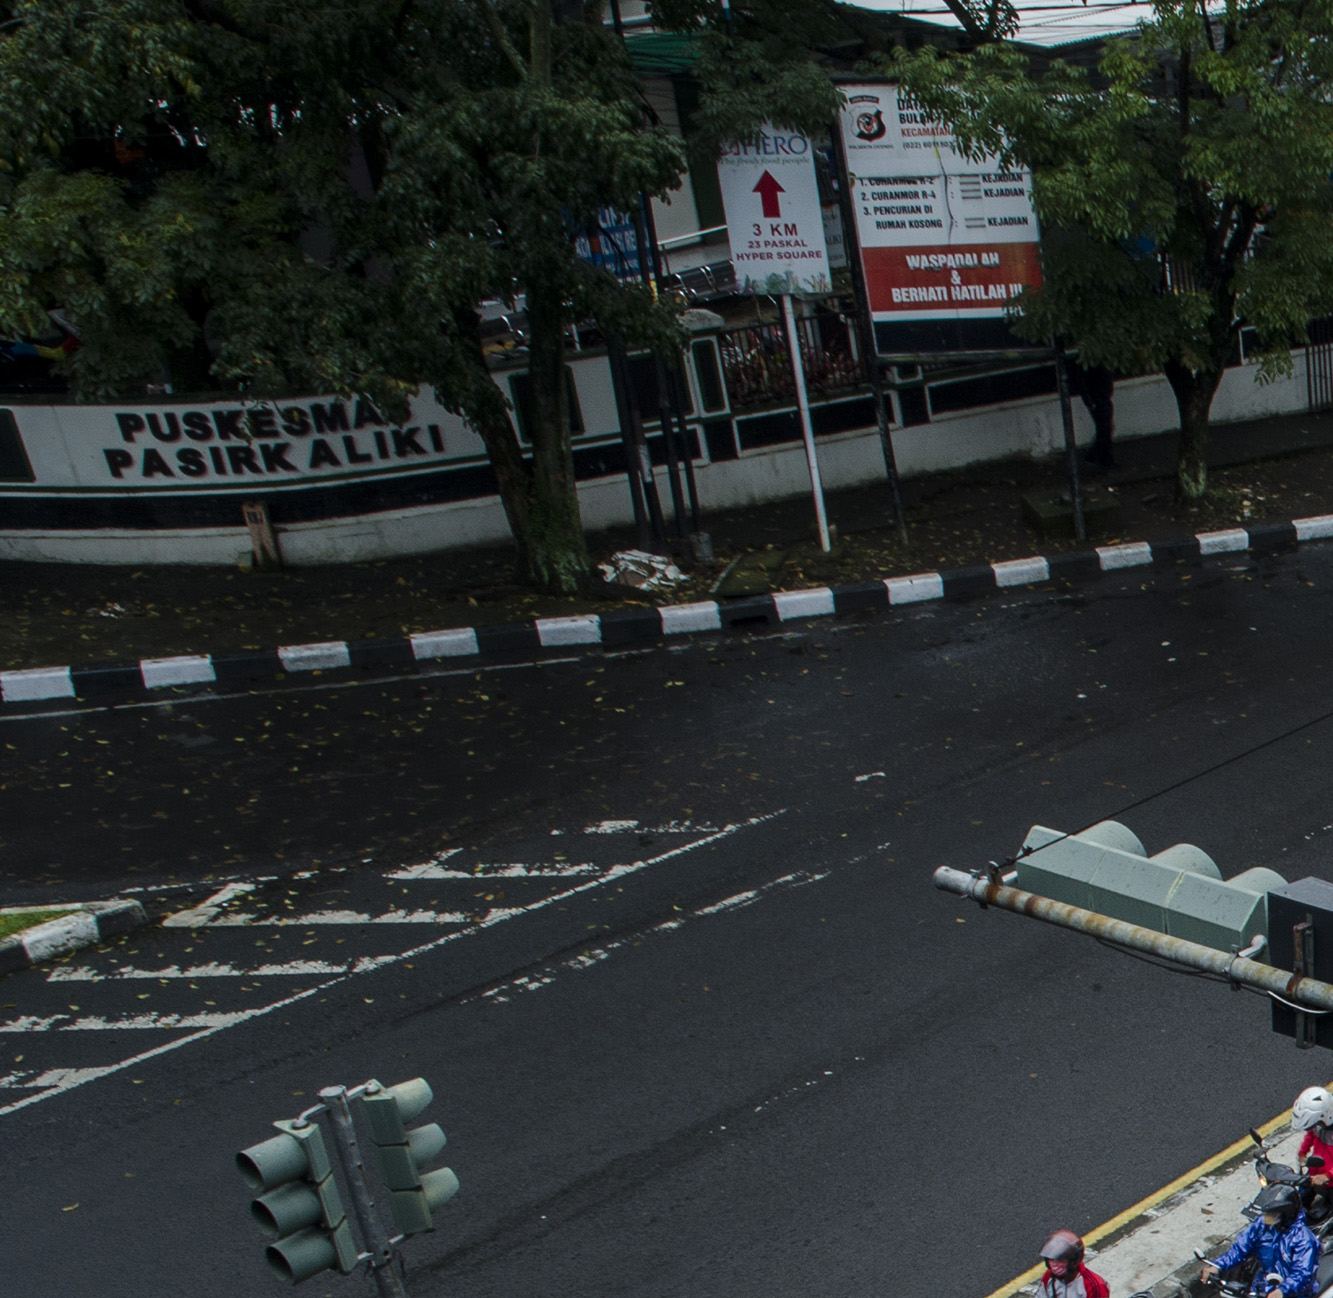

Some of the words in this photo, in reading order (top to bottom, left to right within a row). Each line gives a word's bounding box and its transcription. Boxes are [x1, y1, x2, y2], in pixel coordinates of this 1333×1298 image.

[743, 134, 808, 156] HERO
[871, 190, 920, 201] CURANMOR
[983, 187, 1025, 197] KEJADIAN
[873, 205, 922, 215] PENCURIAN
[923, 205, 933, 214] DI
[876, 220, 907, 230] RUMAH
[908, 219, 943, 229] KOSONG
[987, 216, 1029, 226] KEJADIAN
[752, 223, 762, 237] 3
[770, 223, 798, 237] KM
[748, 241, 761, 249] 23
[764, 240, 808, 249] PASKAL
[736, 252, 773, 261] HYPER
[777, 250, 822, 260] SQUARE
[950, 269, 962, 286] &
[891, 286, 949, 303] BERHATI
[950, 283, 1007, 301] HATILAH
